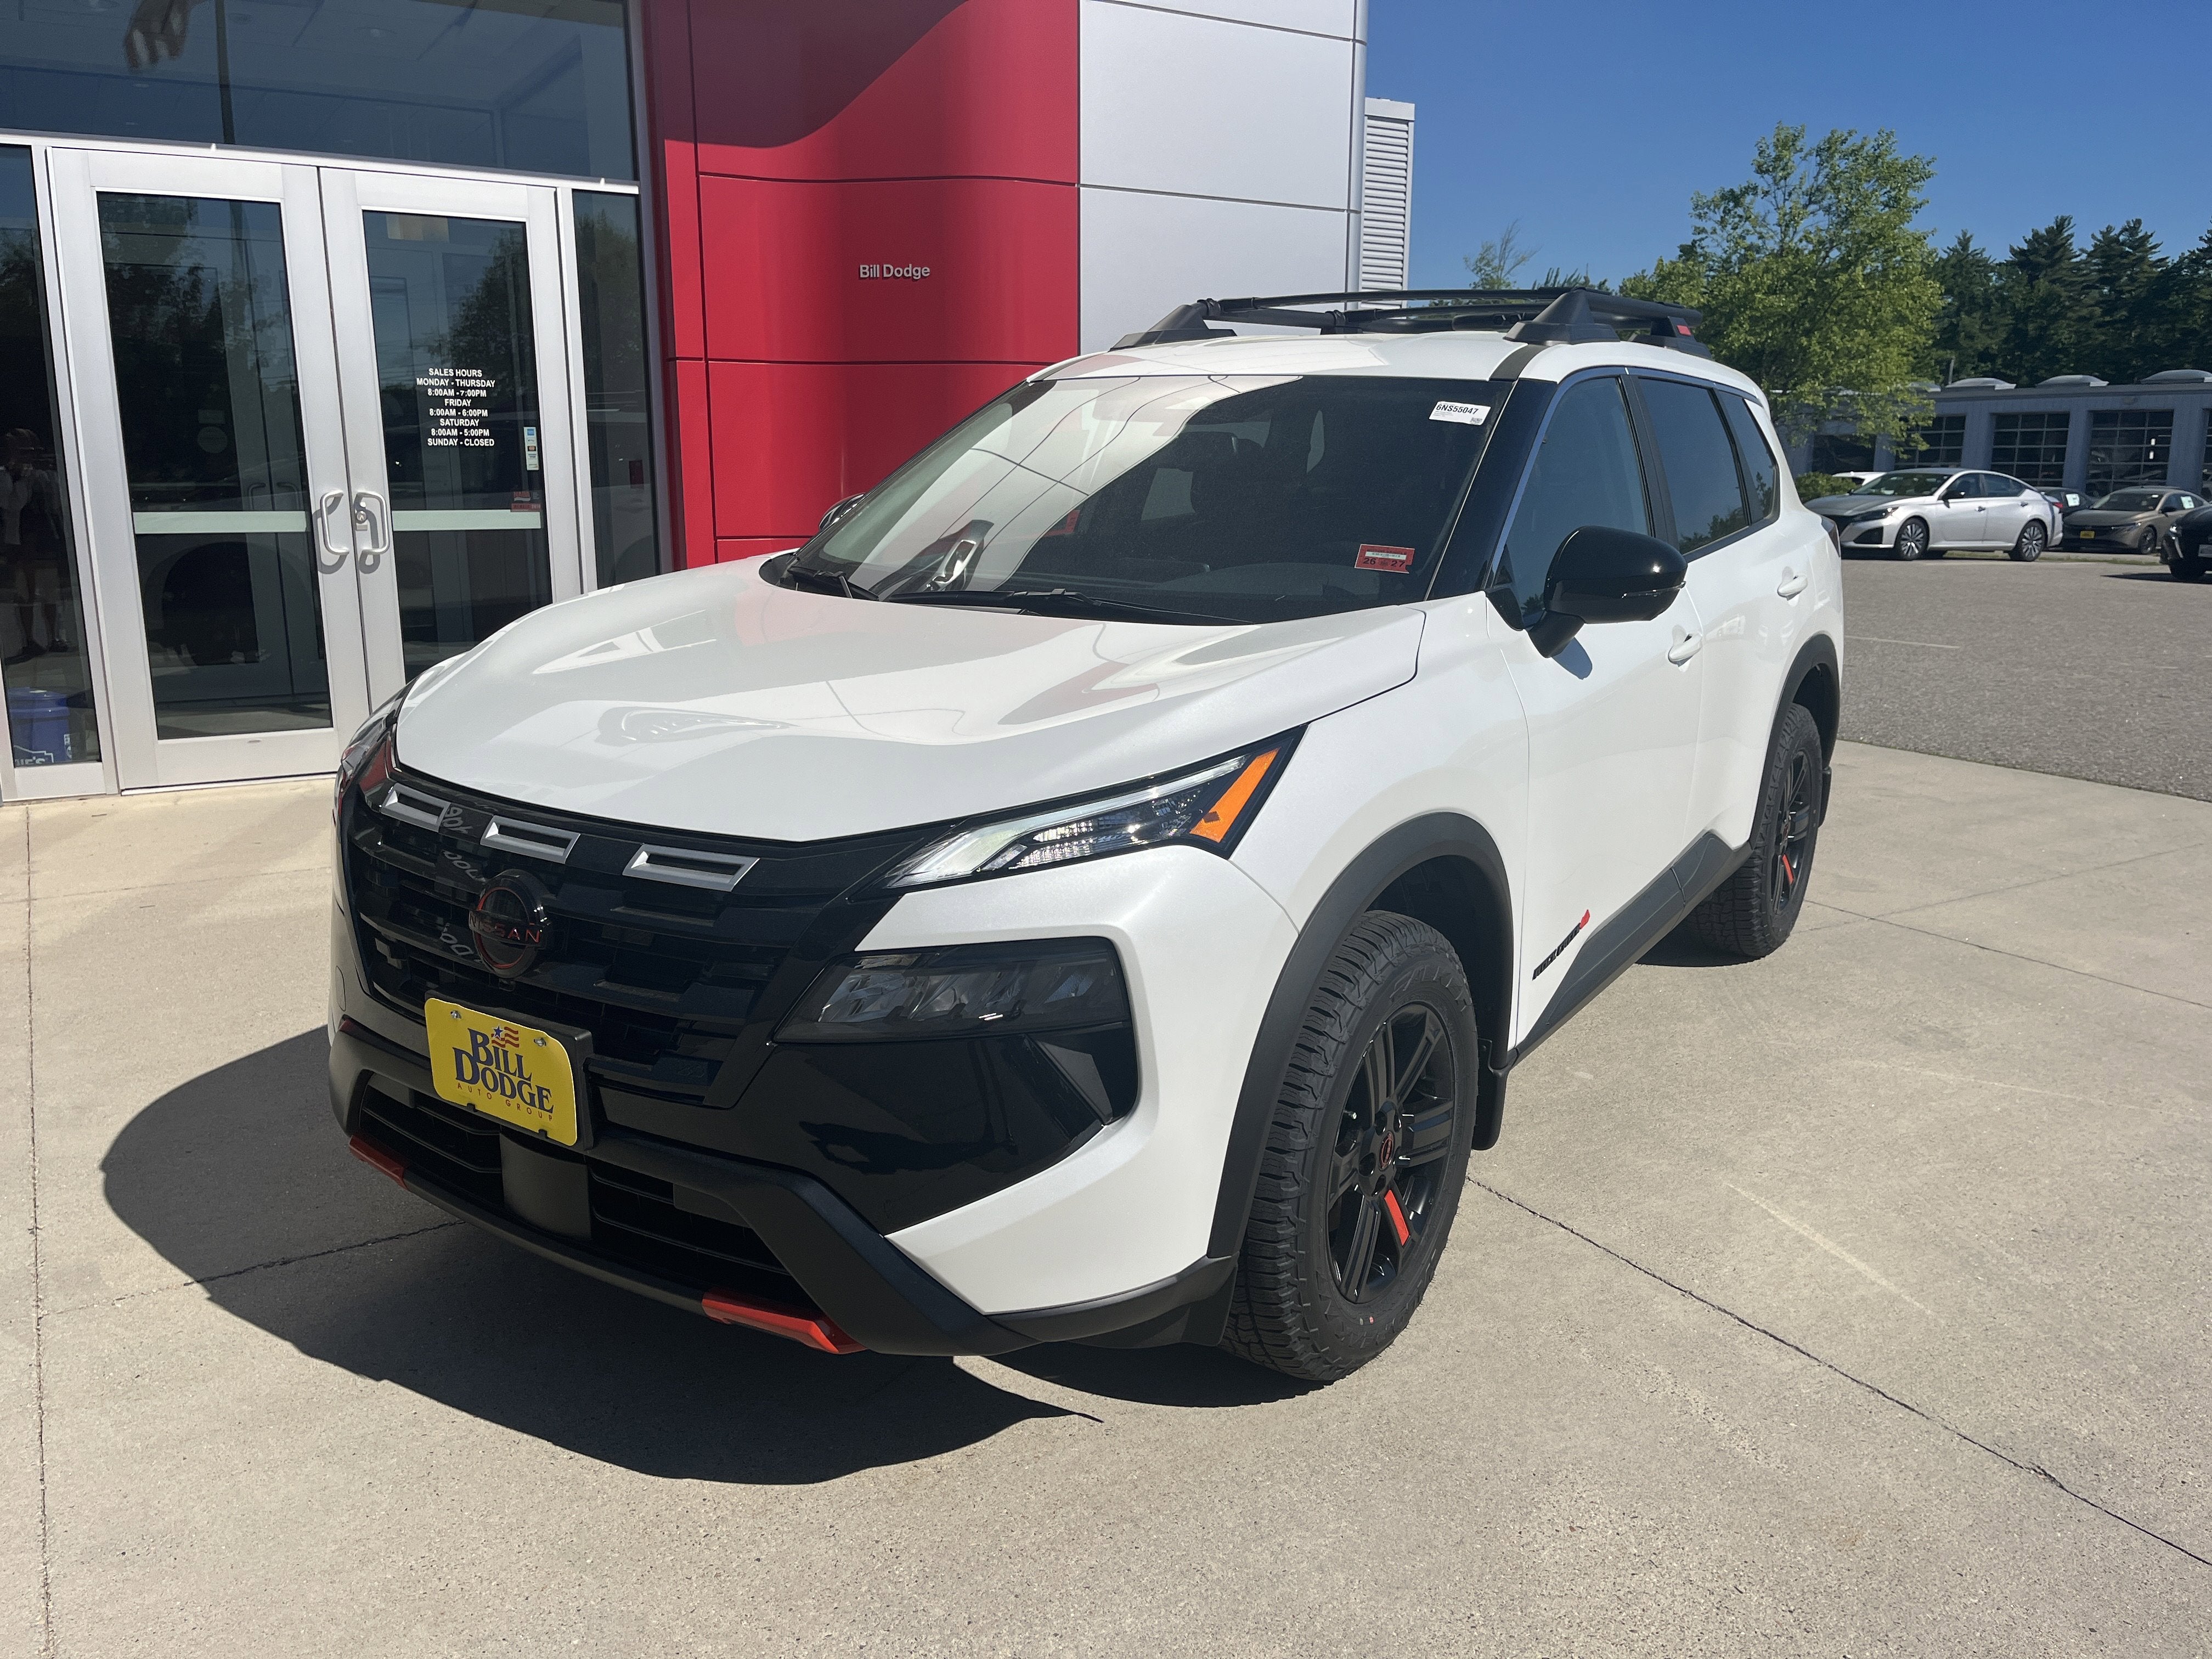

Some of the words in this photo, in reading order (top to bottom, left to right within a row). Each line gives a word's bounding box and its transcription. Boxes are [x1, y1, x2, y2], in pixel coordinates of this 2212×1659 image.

[860, 264, 879, 278] Bill
[883, 263, 930, 279] Dodge
[428, 368, 454, 376] SALES
[455, 369, 483, 377] HOURS
[416, 377, 449, 386] MONDAY
[455, 379, 495, 388] THURSDAY
[427, 388, 455, 397] 8:00AM
[460, 389, 487, 397] 7:00PM
[444, 398, 472, 407] FRIDAY
[429, 408, 456, 416] 8:00AM
[462, 409, 488, 417] 6:00PM
[1436, 404, 1480, 415] 6NS55047
[439, 418, 479, 427] SATURDAY
[431, 428, 458, 436] 8:00AM
[464, 428, 490, 437] 5:00PM
[427, 438, 459, 446] SUNDAY
[464, 438, 495, 447] CLOSED
[469, 911, 541, 944] NISSAN
[467, 1028, 532, 1082] BILL
[452, 1047, 554, 1114] DODGE
[457, 1082, 493, 1100] AUTO
[505, 1099, 553, 1122] GROUP
